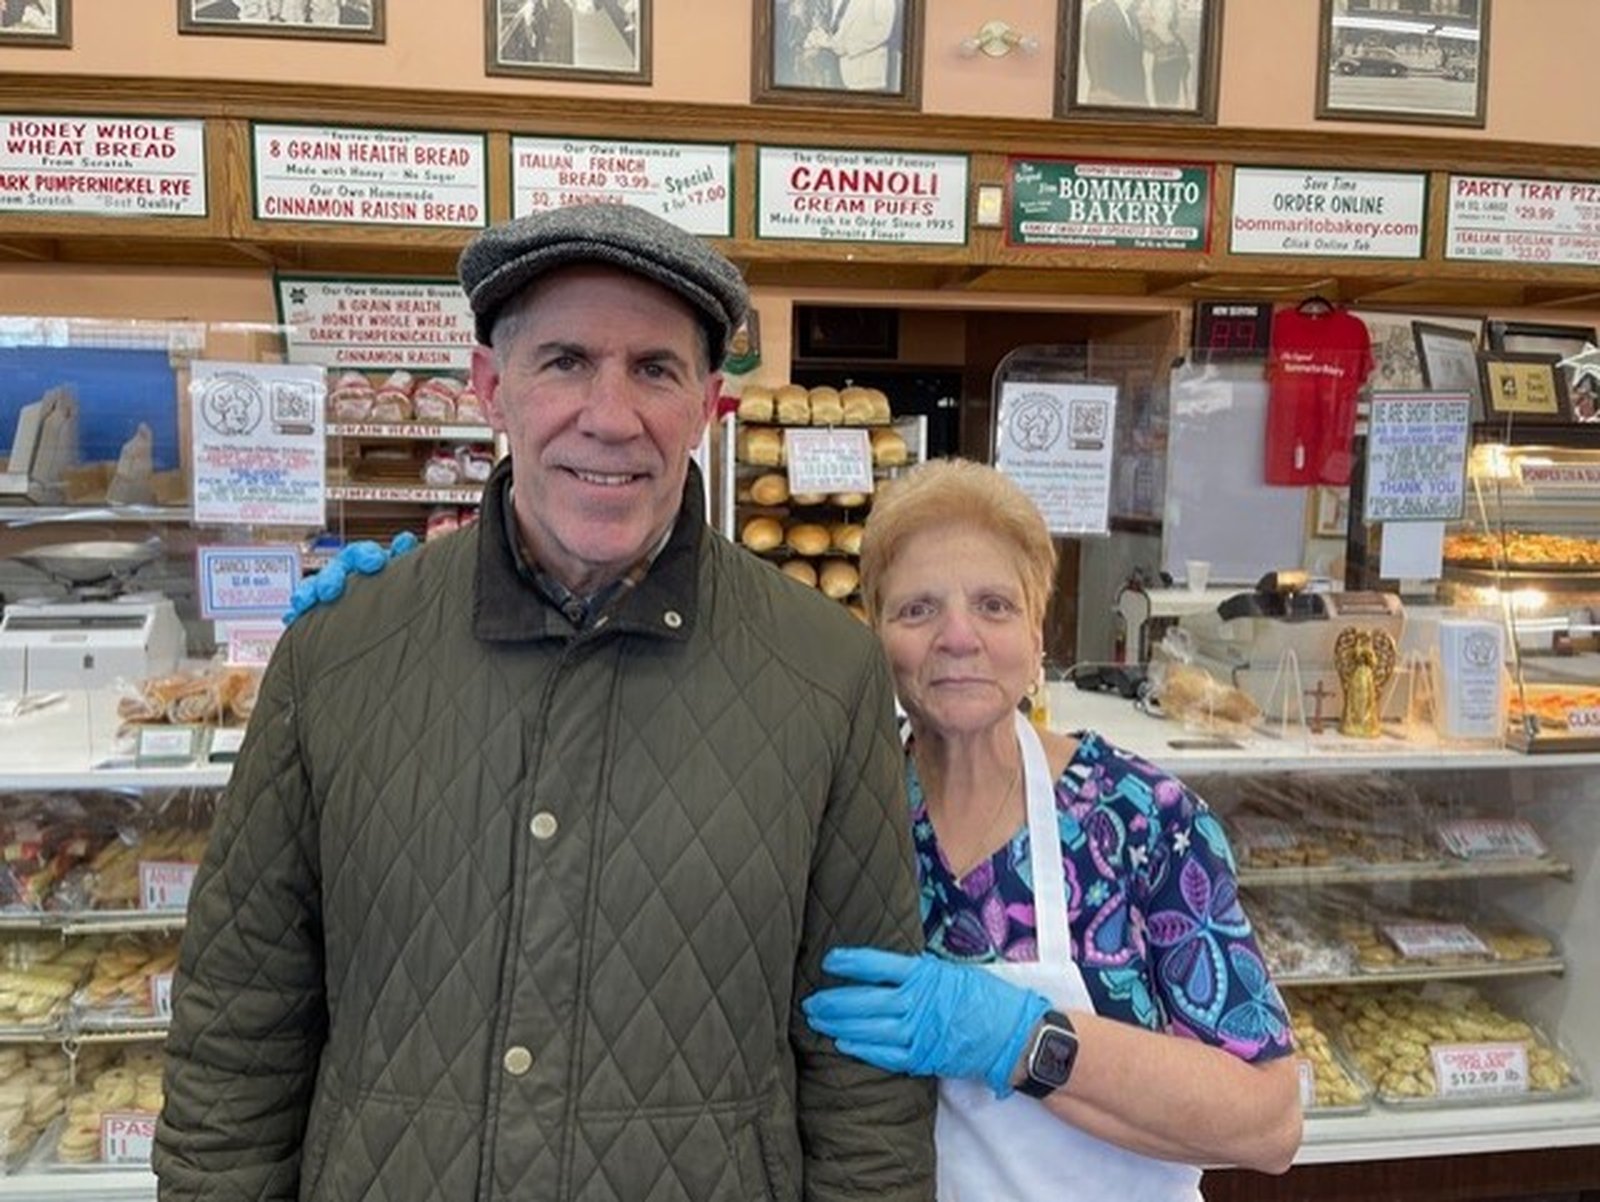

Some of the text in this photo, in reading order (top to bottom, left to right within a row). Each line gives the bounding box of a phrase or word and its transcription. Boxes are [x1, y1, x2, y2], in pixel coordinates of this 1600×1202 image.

[10, 122, 176, 140] HONEY WHOLE
[7, 140, 176, 158] WHEAT BREAD
[269, 139, 471, 167] 8 GRAIN HEALTH BREAD
[564, 143, 681, 158] Our Own Homemade
[42, 157, 133, 168] From Scratch
[519, 154, 647, 173] ITALIAN FRENCH
[793, 152, 937, 169] The Original World Famous
[286, 164, 456, 183] Made with Honey No Sugar
[559, 172, 608, 187] BREAD
[665, 165, 716, 195] Special
[790, 166, 939, 196] CANNOLI
[36, 175, 154, 195] PUMPERNICKEL
[160, 178, 192, 195] RYE
[309, 183, 434, 201] Our Own Homemade
[1058, 177, 1200, 205] BOMMARITO
[1303, 175, 1357, 192] Save Time
[1457, 179, 1513, 198] PARTY
[1519, 182, 1564, 201] TRAY
[687, 185, 727, 206] $7.00
[1273, 194, 1385, 215] ORDER ONLINE
[265, 195, 479, 223] CINNAMON RAISIN BREAD
[793, 196, 934, 216] CREAM PUFFS
[1069, 201, 1179, 226] BAKERY
[769, 213, 800, 225] Made
[804, 215, 835, 226] Fresh
[855, 217, 887, 229] Order
[892, 218, 922, 229] Since
[1234, 216, 1419, 238] bommaritobakery.com
[1282, 237, 1371, 251] Click Online Tab
[1456, 232, 1501, 244] ITALIAN
[322, 285, 341, 296] Our
[344, 286, 367, 296] Own
[370, 286, 424, 298] Homemade
[351, 299, 391, 312] GRAIN
[395, 300, 441, 313] HEALTH
[1211, 306, 1259, 317] NOW SERVING
[321, 313, 365, 326] HONEY
[368, 314, 412, 327] WHOLE
[415, 314, 457, 328] WHEAT
[309, 328, 344, 340] DARK
[336, 349, 451, 363] CINNAMON RAISIN
[1389, 402, 1404, 423] ARE
[1407, 402, 1433, 423] SHORT
[335, 424, 441, 435] GRAIN HEALTH
[1379, 480, 1457, 495] THANK YOU
[1451, 1071, 1499, 1086] $12.99
